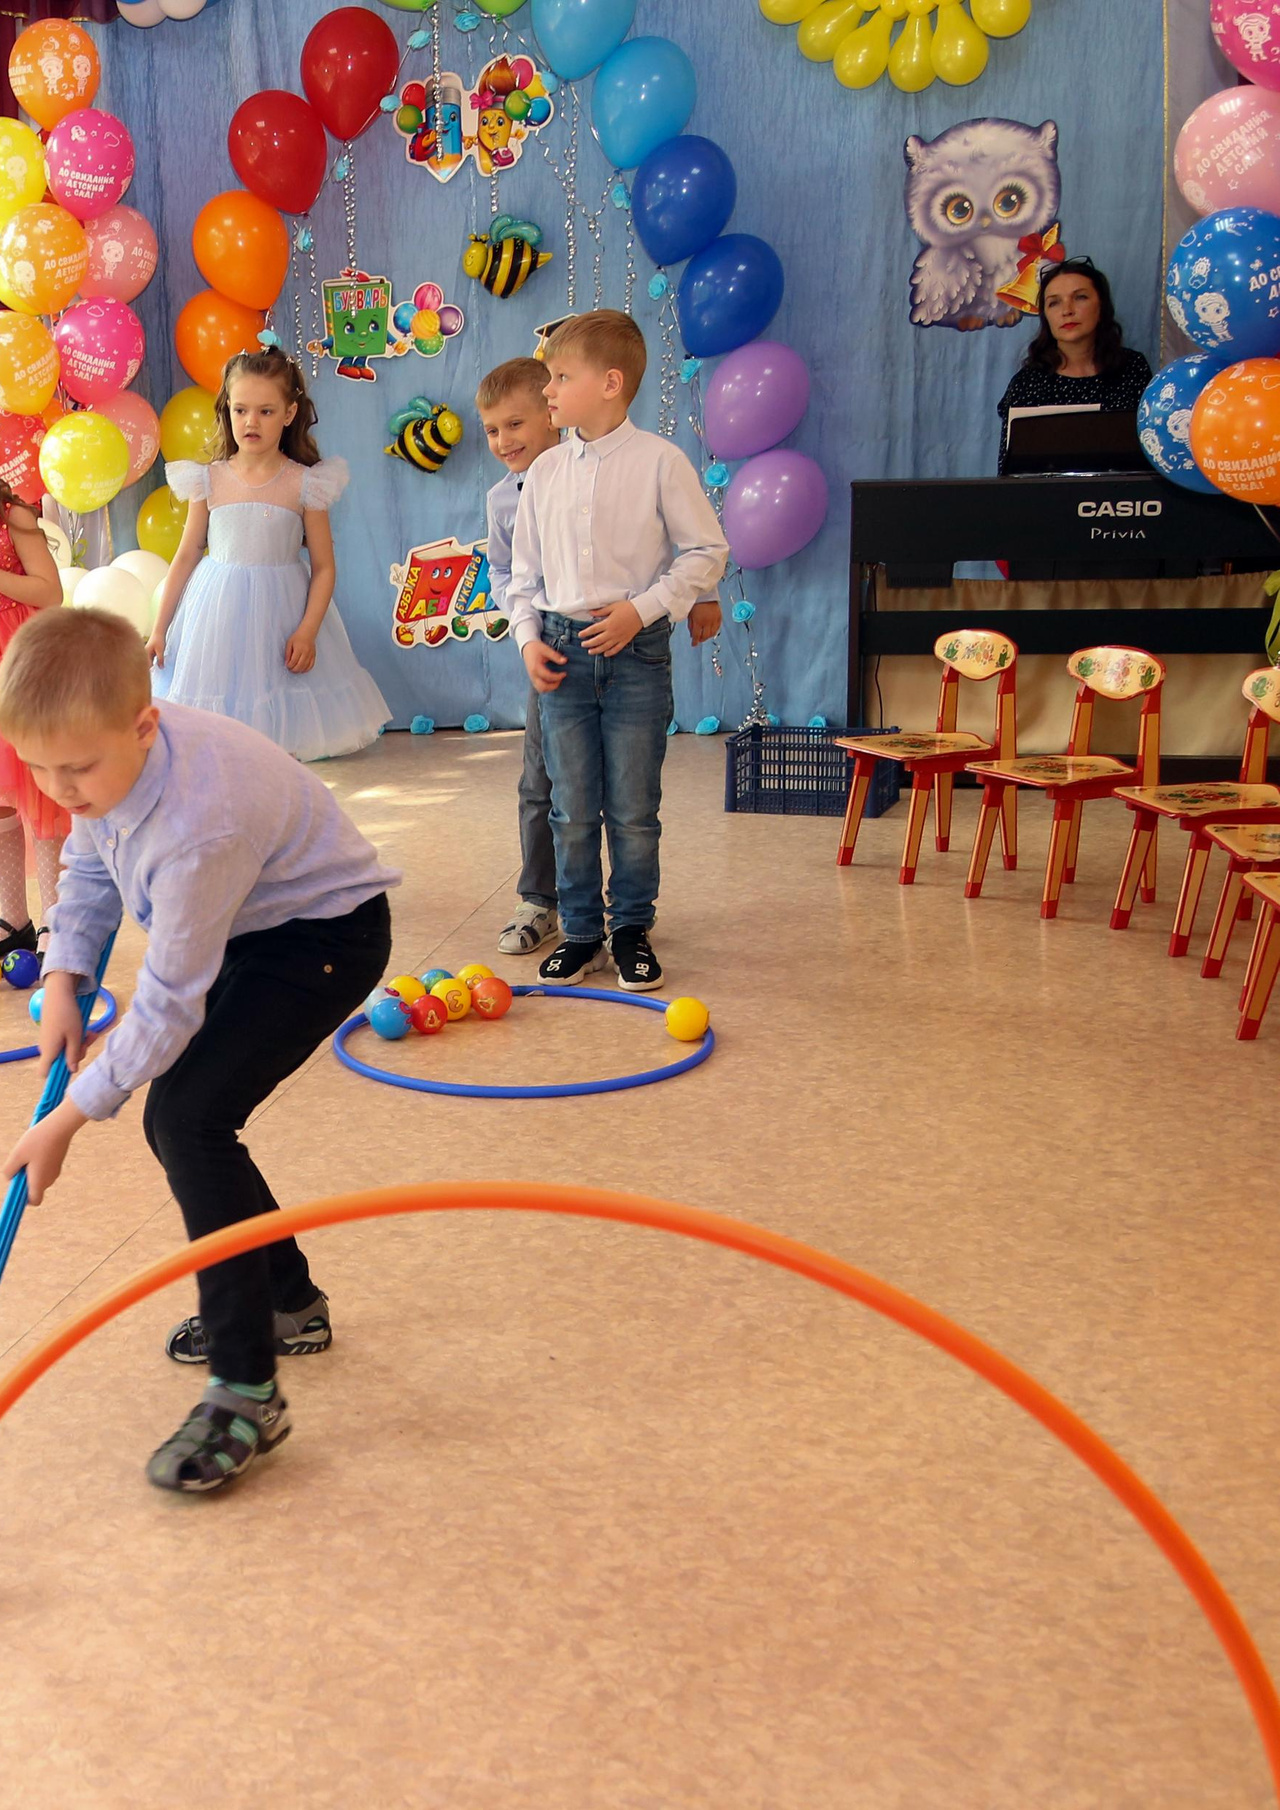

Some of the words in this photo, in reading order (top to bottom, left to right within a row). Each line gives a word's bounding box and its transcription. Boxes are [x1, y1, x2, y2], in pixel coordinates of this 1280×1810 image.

[58, 167, 70, 178] ДО
[1195, 157, 1211, 178] ДО
[43, 259, 57, 271] ДО
[1249, 273, 1269, 292] ДО
[61, 344, 72, 356] ДО
[1203, 457, 1216, 470] ДО
[1077, 500, 1162, 517] CASIO
[408, 596, 449, 619] АБВ
[3, 952, 20, 973] 5
